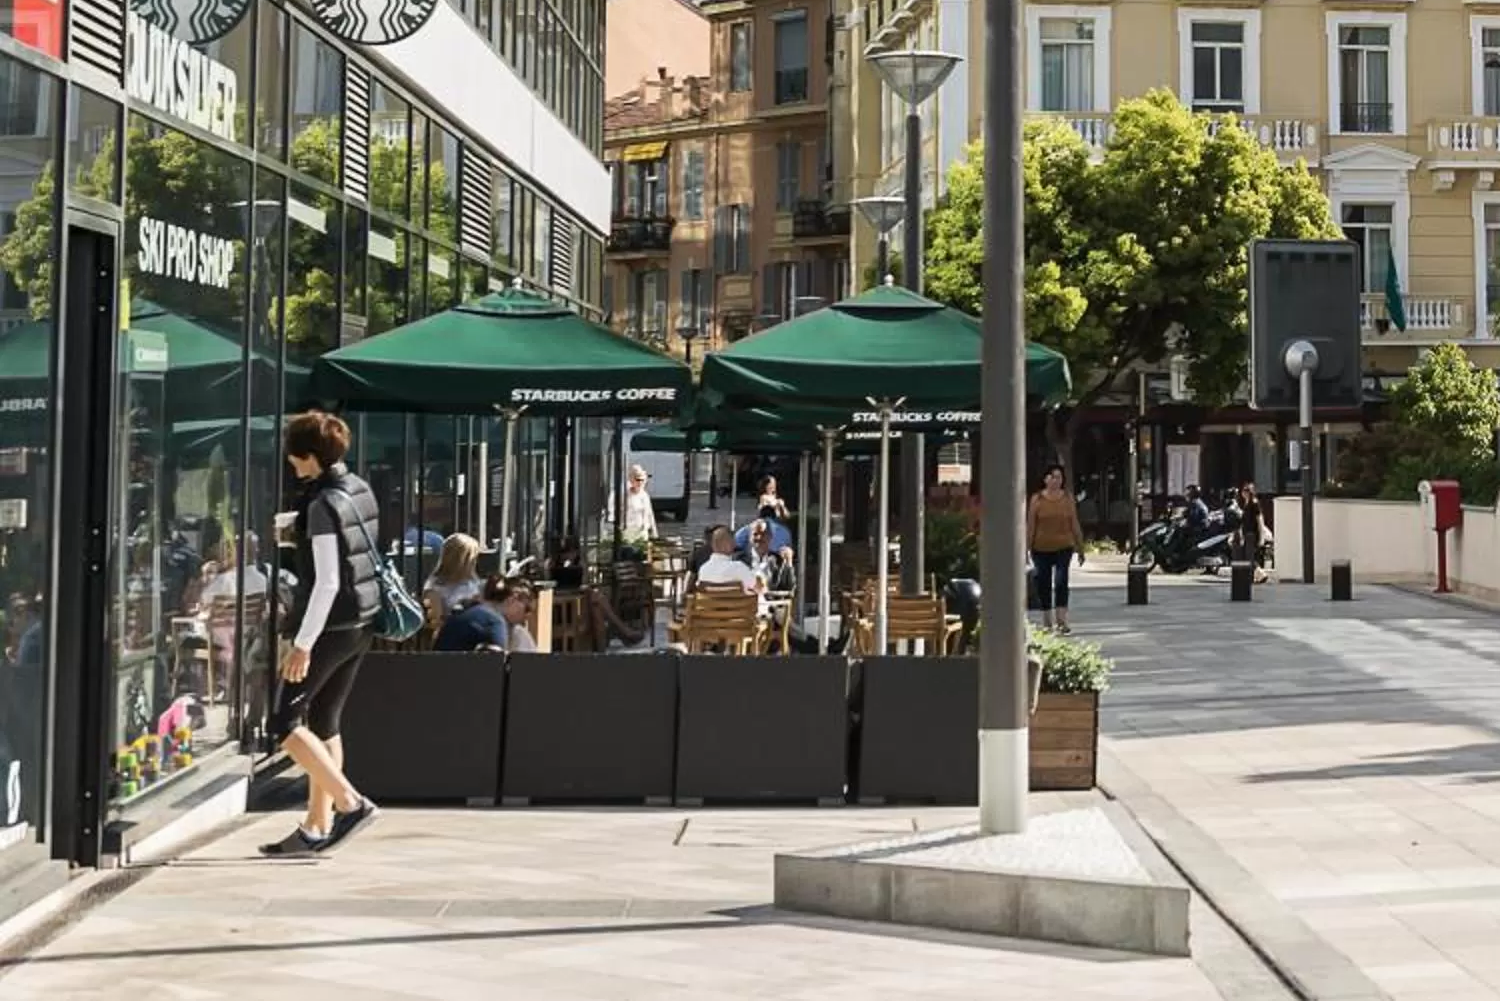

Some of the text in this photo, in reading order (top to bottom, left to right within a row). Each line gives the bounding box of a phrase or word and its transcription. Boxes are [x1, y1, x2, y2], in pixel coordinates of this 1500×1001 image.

[138, 216, 234, 289] SKI PRO SHOP
[511, 388, 676, 402] STARBUCKS COFFEE
[852, 411, 933, 422] STABUCKS
